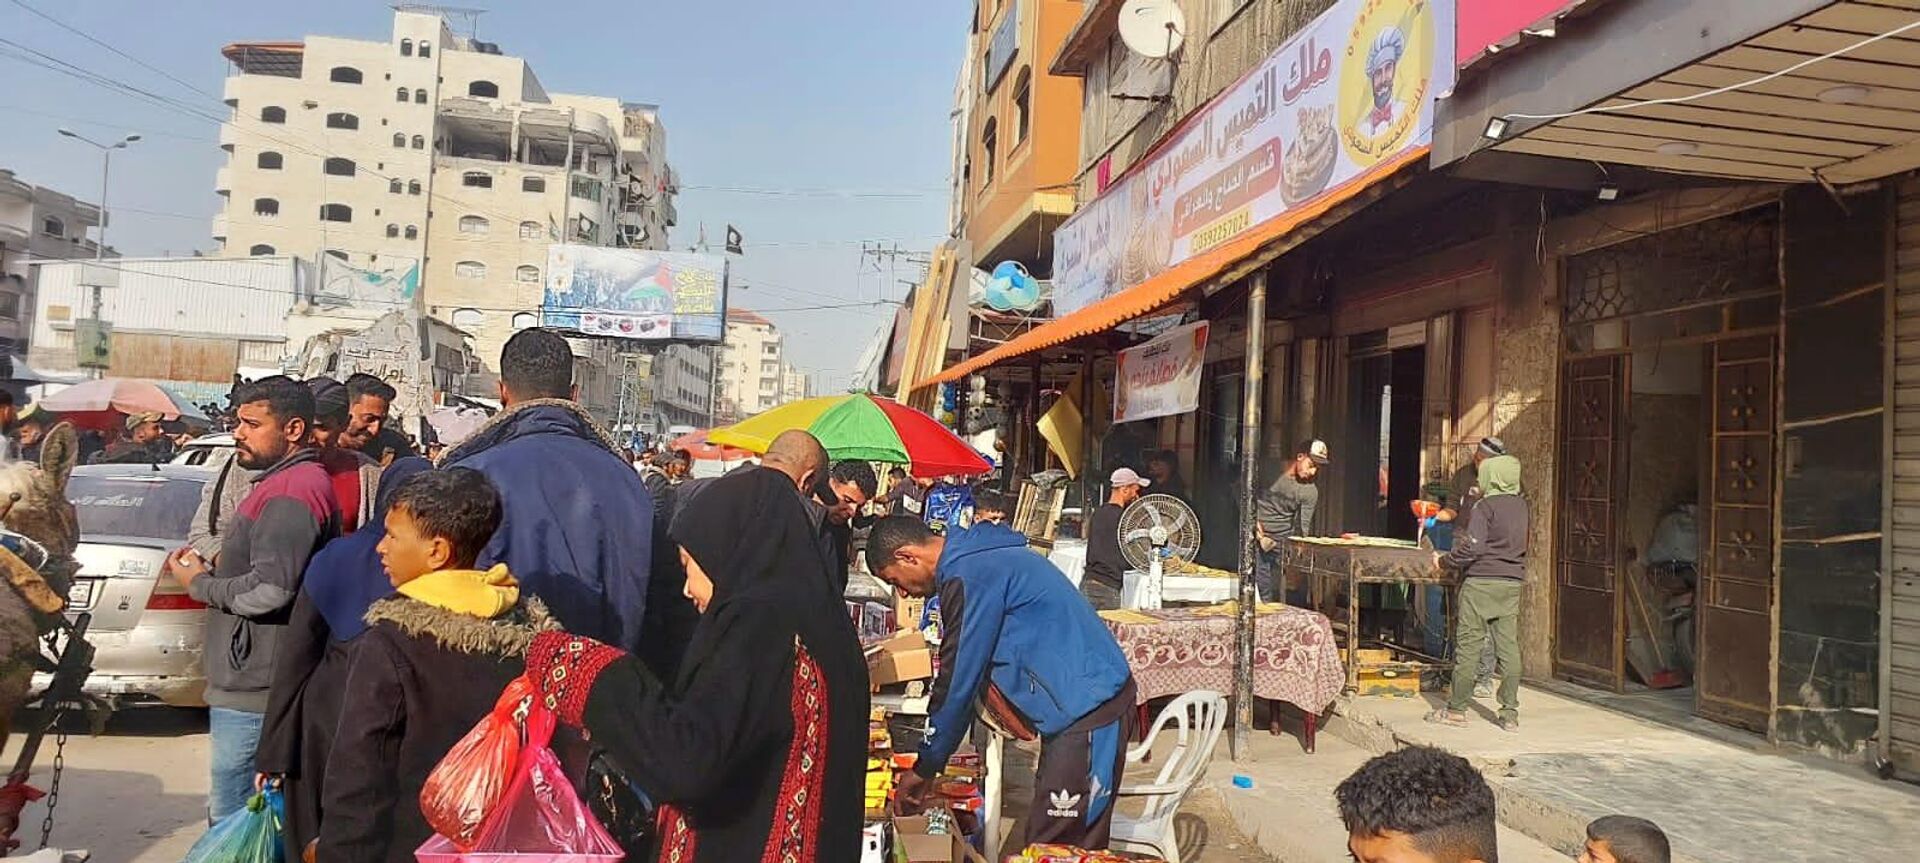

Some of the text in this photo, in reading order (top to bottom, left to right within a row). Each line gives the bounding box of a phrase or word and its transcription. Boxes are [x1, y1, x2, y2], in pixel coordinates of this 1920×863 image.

[1152, 36, 1333, 206] ملك التميس السعودي
[1215, 161, 1244, 212] الصاج
[1246, 143, 1275, 193] قسم
[1047, 809, 1079, 817] adidas
